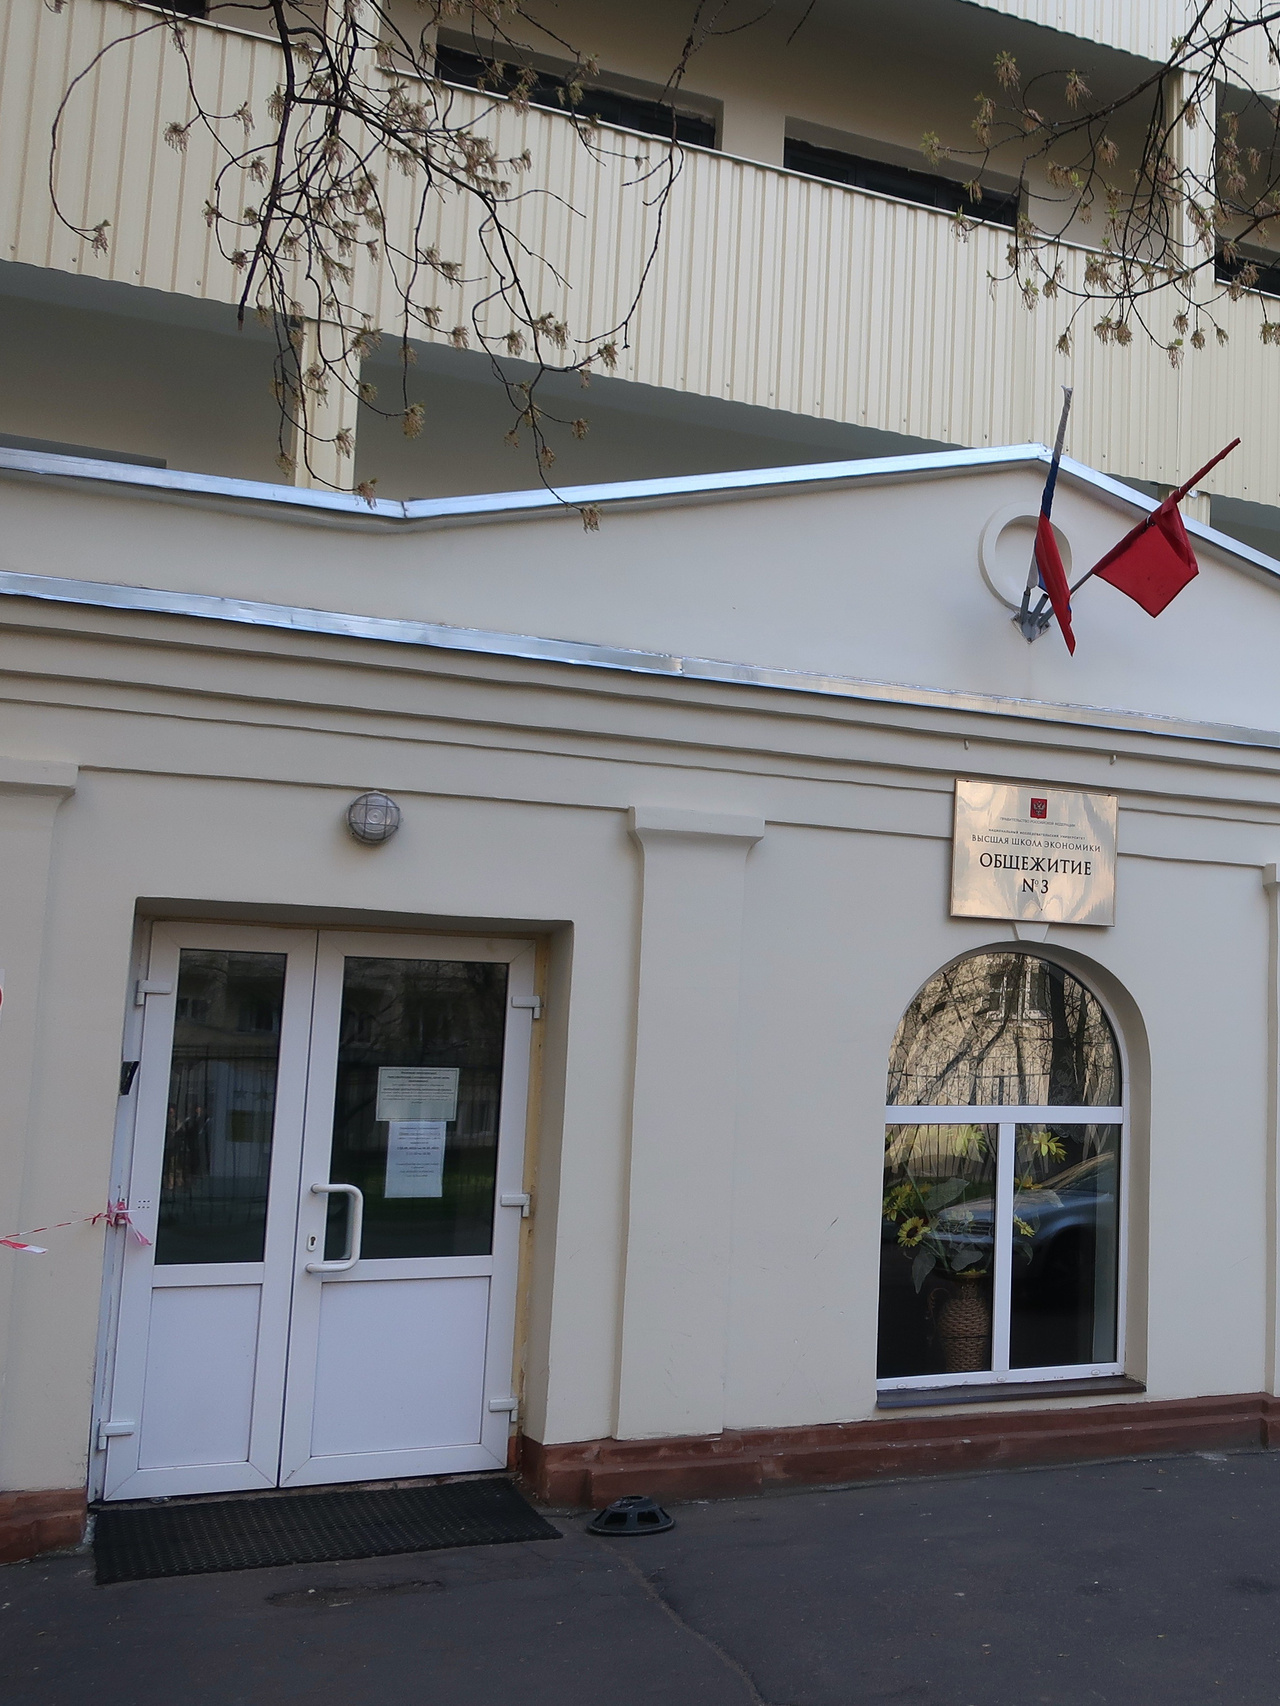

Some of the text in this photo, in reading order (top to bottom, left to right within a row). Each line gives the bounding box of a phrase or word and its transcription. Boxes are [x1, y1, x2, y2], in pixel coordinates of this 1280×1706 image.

[971, 834, 1101, 853] ВЫСШАЯ ШКОЛА ЭКОНОМИКИ
[979, 852, 1092, 876] ОБЩЕЖИТИЕ
